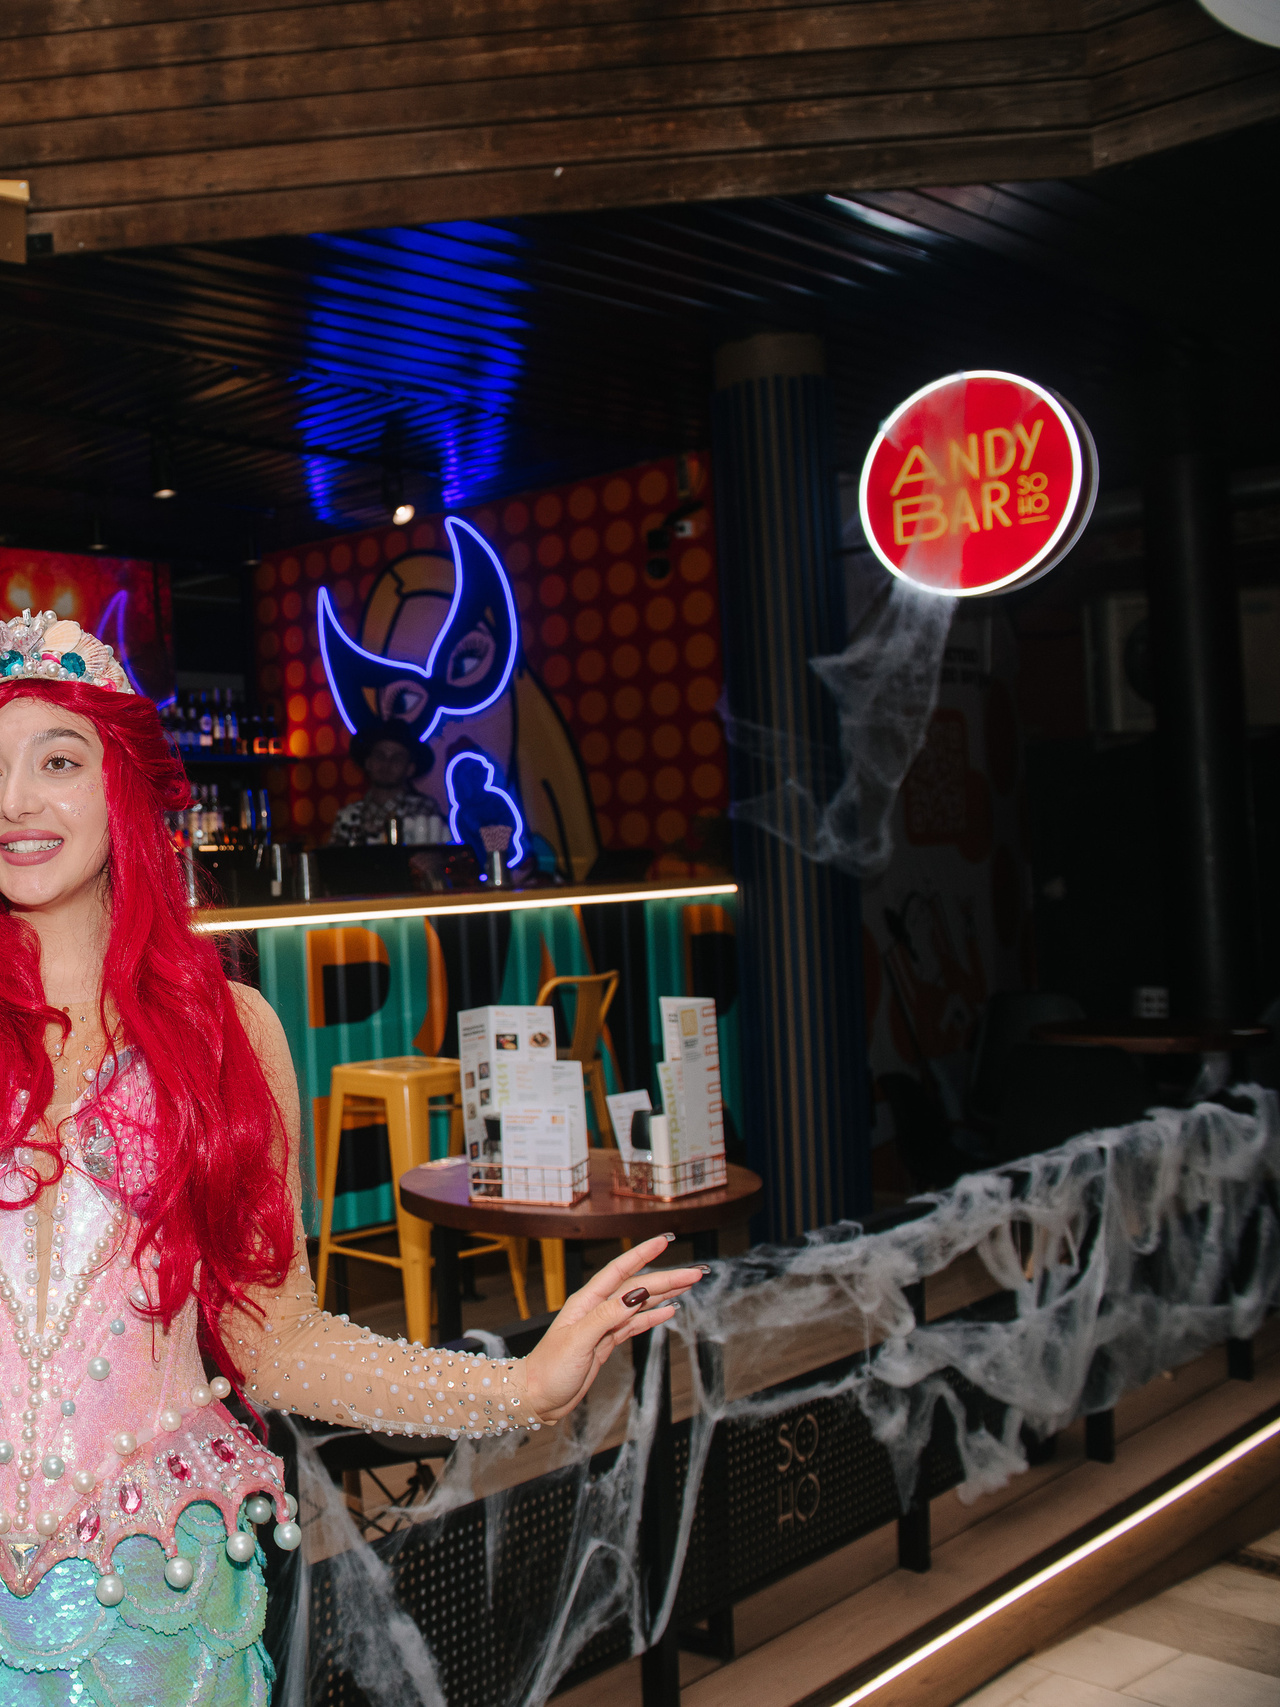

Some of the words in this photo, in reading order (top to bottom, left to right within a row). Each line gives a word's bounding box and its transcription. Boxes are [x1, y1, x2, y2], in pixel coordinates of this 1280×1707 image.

[890, 419, 1044, 497] ANDY
[1016, 472, 1049, 495] SO
[893, 480, 1013, 546] BAR
[1017, 493, 1050, 517] HO
[777, 1413, 819, 1472] SO
[777, 1472, 821, 1536] HO
